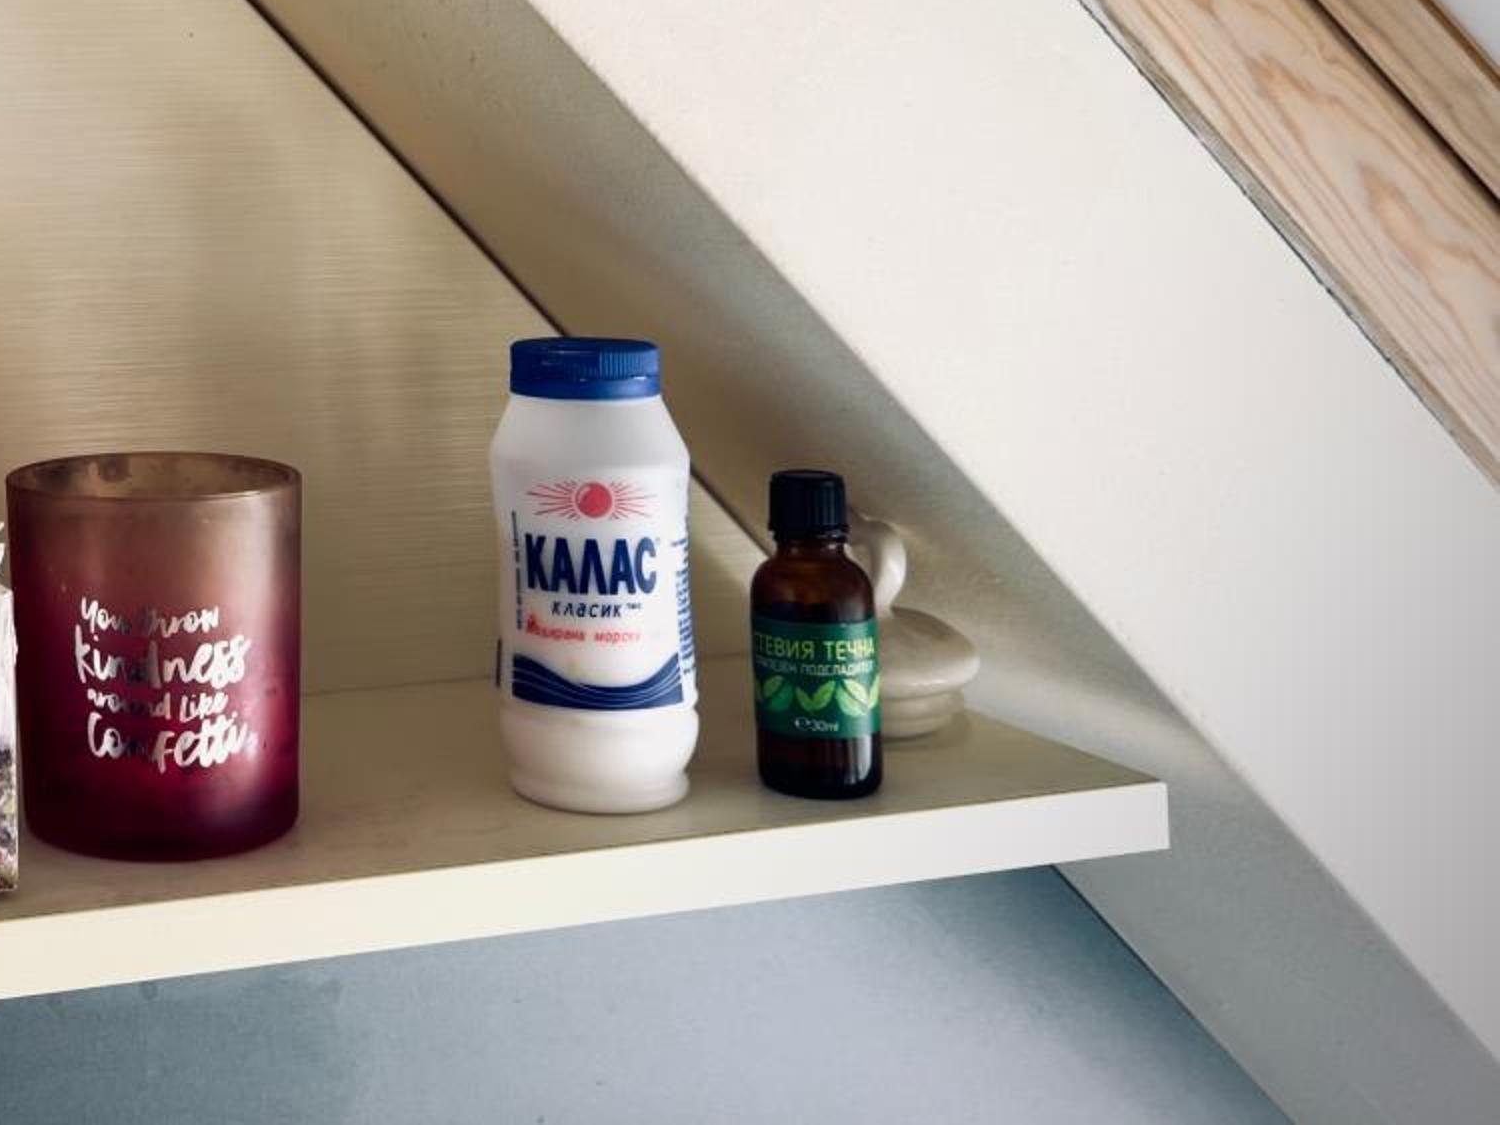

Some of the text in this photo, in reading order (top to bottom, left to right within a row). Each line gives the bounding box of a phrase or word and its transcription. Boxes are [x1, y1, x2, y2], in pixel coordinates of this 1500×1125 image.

[525, 533, 657, 596] КАЛАС
[551, 601, 622, 619] класик
[755, 634, 815, 661] ТЕВИЯ
